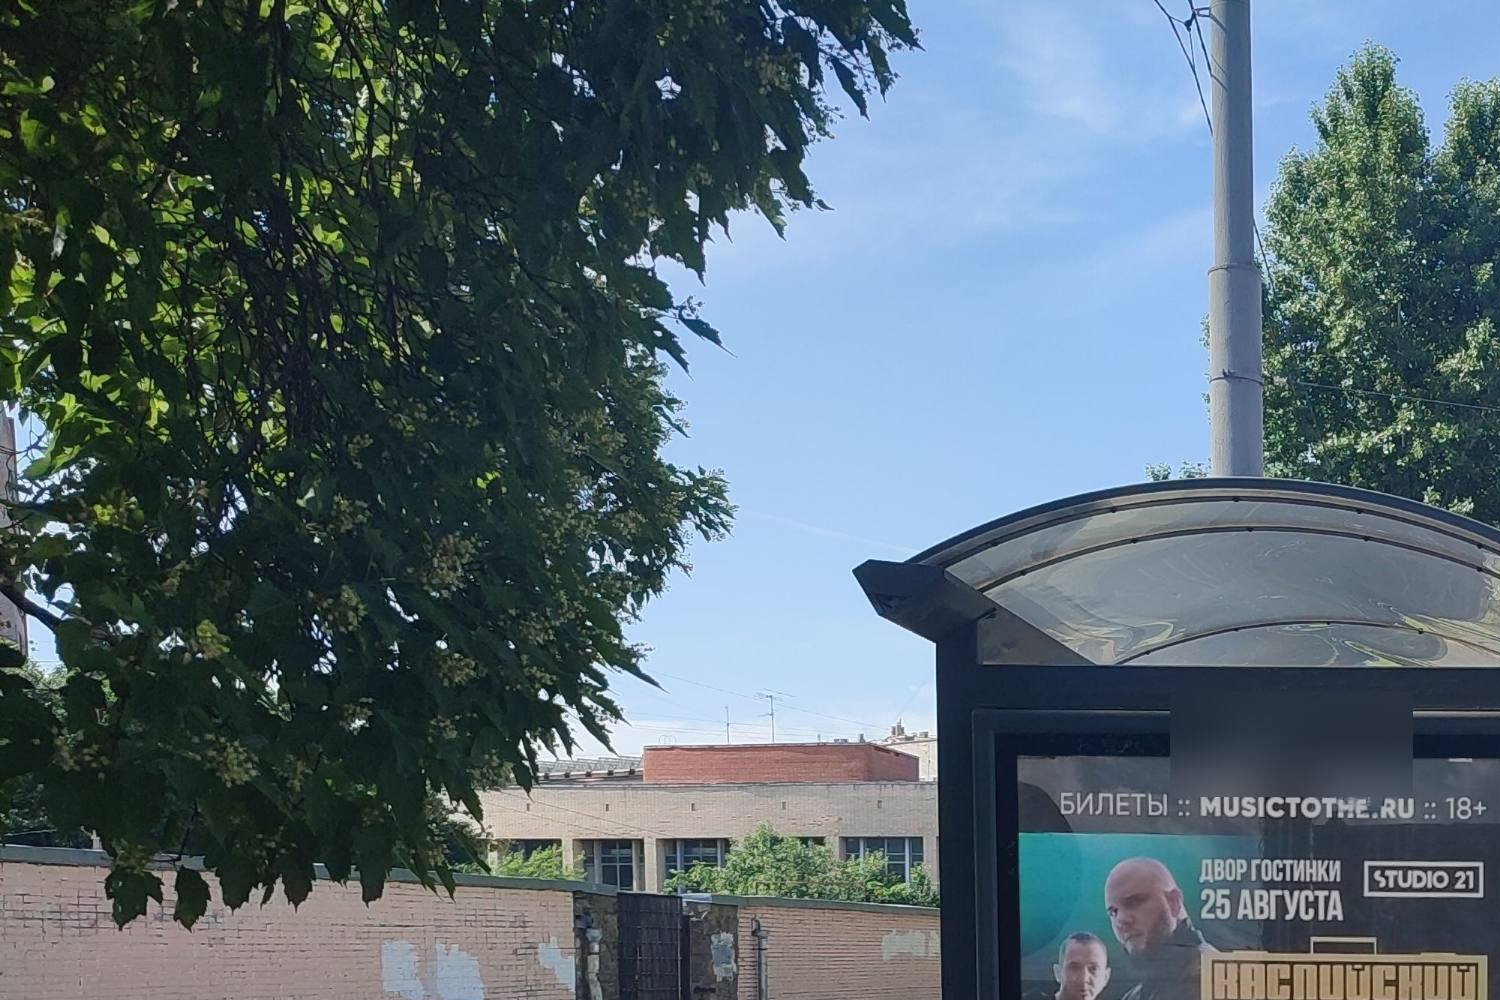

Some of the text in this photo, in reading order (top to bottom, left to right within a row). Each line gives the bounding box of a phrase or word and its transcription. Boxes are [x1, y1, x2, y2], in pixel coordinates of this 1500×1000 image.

[1060, 793, 1167, 816] БИЛЕТЫ
[1201, 796, 1415, 819] MUSICTOTHE.RU
[1445, 798, 1487, 819] 18+
[1199, 858, 1341, 883] ДВОР ГОСТИНКИ
[1374, 869, 1474, 890] STUDIO 21
[1200, 888, 1344, 921] 25 АВГУСТА
